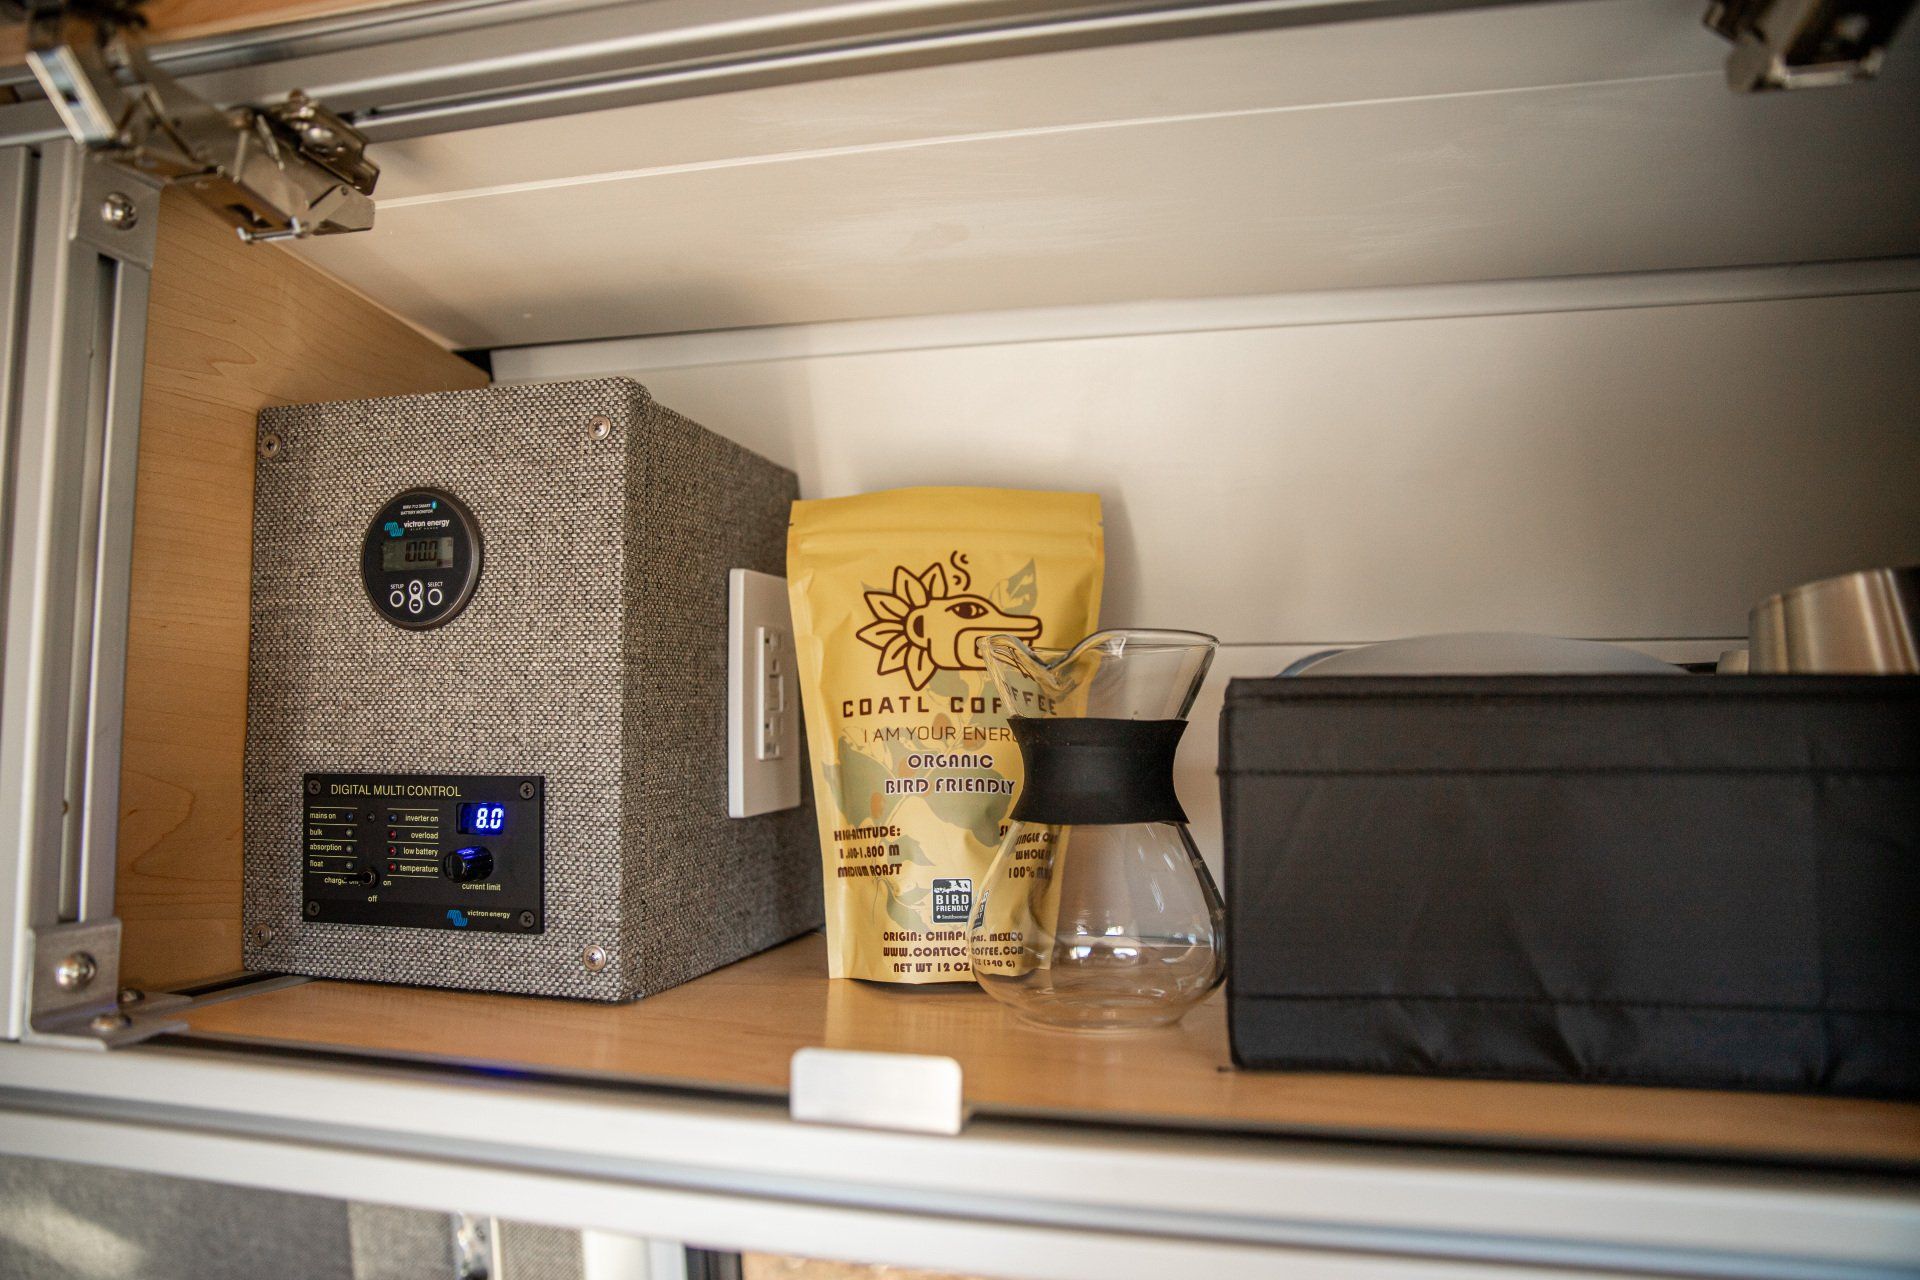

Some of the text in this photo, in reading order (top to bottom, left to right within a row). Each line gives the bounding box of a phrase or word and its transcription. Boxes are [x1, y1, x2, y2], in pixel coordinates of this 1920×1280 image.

[843, 696, 929, 718] COATL
[864, 729, 867, 742] I
[873, 727, 900, 742] AM
[905, 726, 956, 740] YOUR
[908, 754, 993, 768] ORGANIC
[331, 784, 462, 797] DIGITAL MULTI CONTROL
[885, 778, 1015, 795] BIRD FRIENDLY
[405, 814, 429, 822] inverter
[475, 808, 504, 829] 8.0
[309, 844, 342, 852] absorption
[415, 848, 439, 856] battery
[400, 864, 439, 872] temperature
[869, 863, 903, 877] ROAST
[1008, 865, 1035, 879] 100%
[461, 883, 486, 891] current
[935, 894, 970, 905] BIRD
[883, 932, 922, 942] ORIGIN:
[893, 962, 912, 973] NET
[915, 962, 933, 973] WT
[937, 962, 951, 973] 12
[953, 961, 970, 972] OZ
